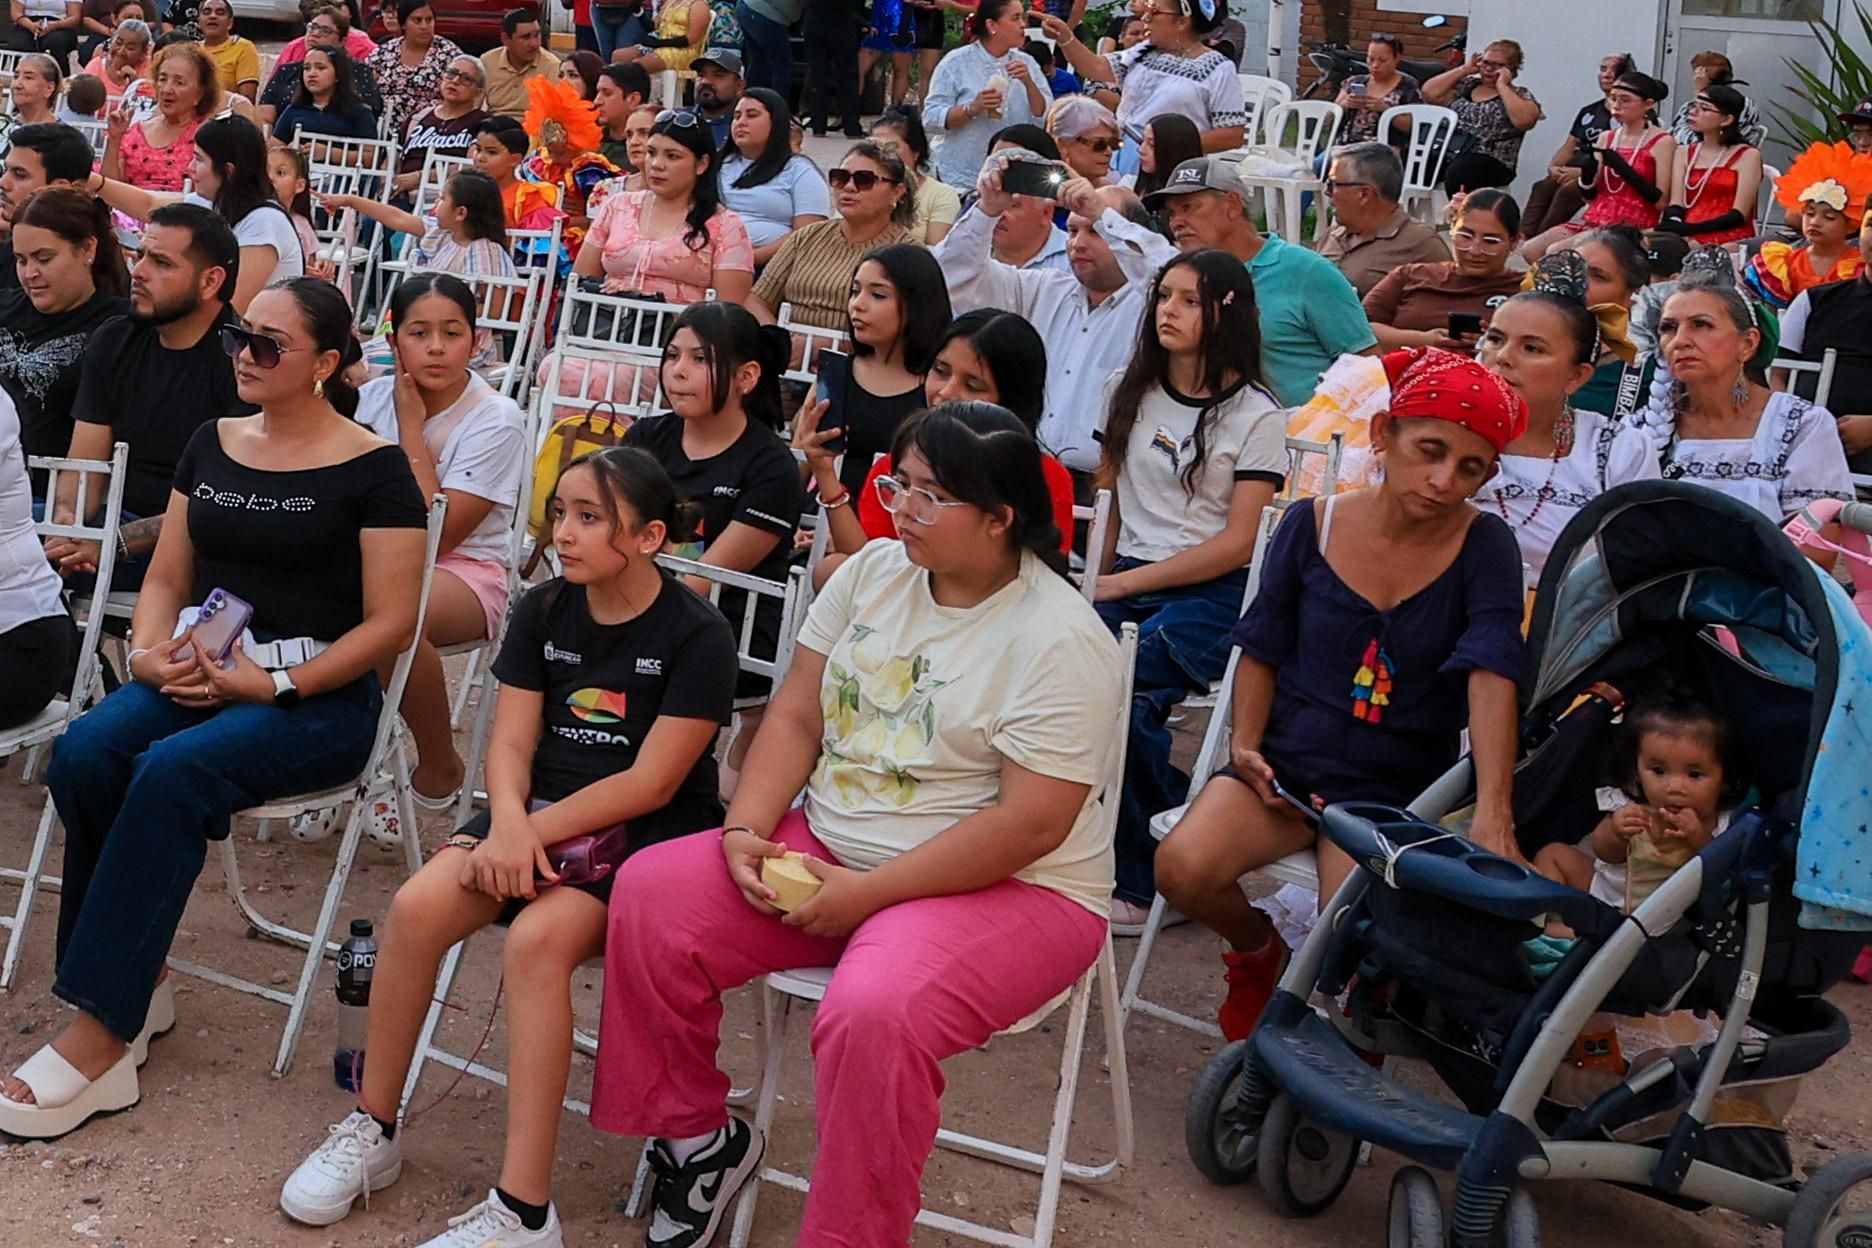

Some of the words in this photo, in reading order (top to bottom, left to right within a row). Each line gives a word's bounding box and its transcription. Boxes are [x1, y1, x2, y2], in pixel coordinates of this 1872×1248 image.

[1178, 168, 1201, 179] TSL
[1616, 373, 1640, 416] BIMBA
[636, 658, 662, 669] IMCC
